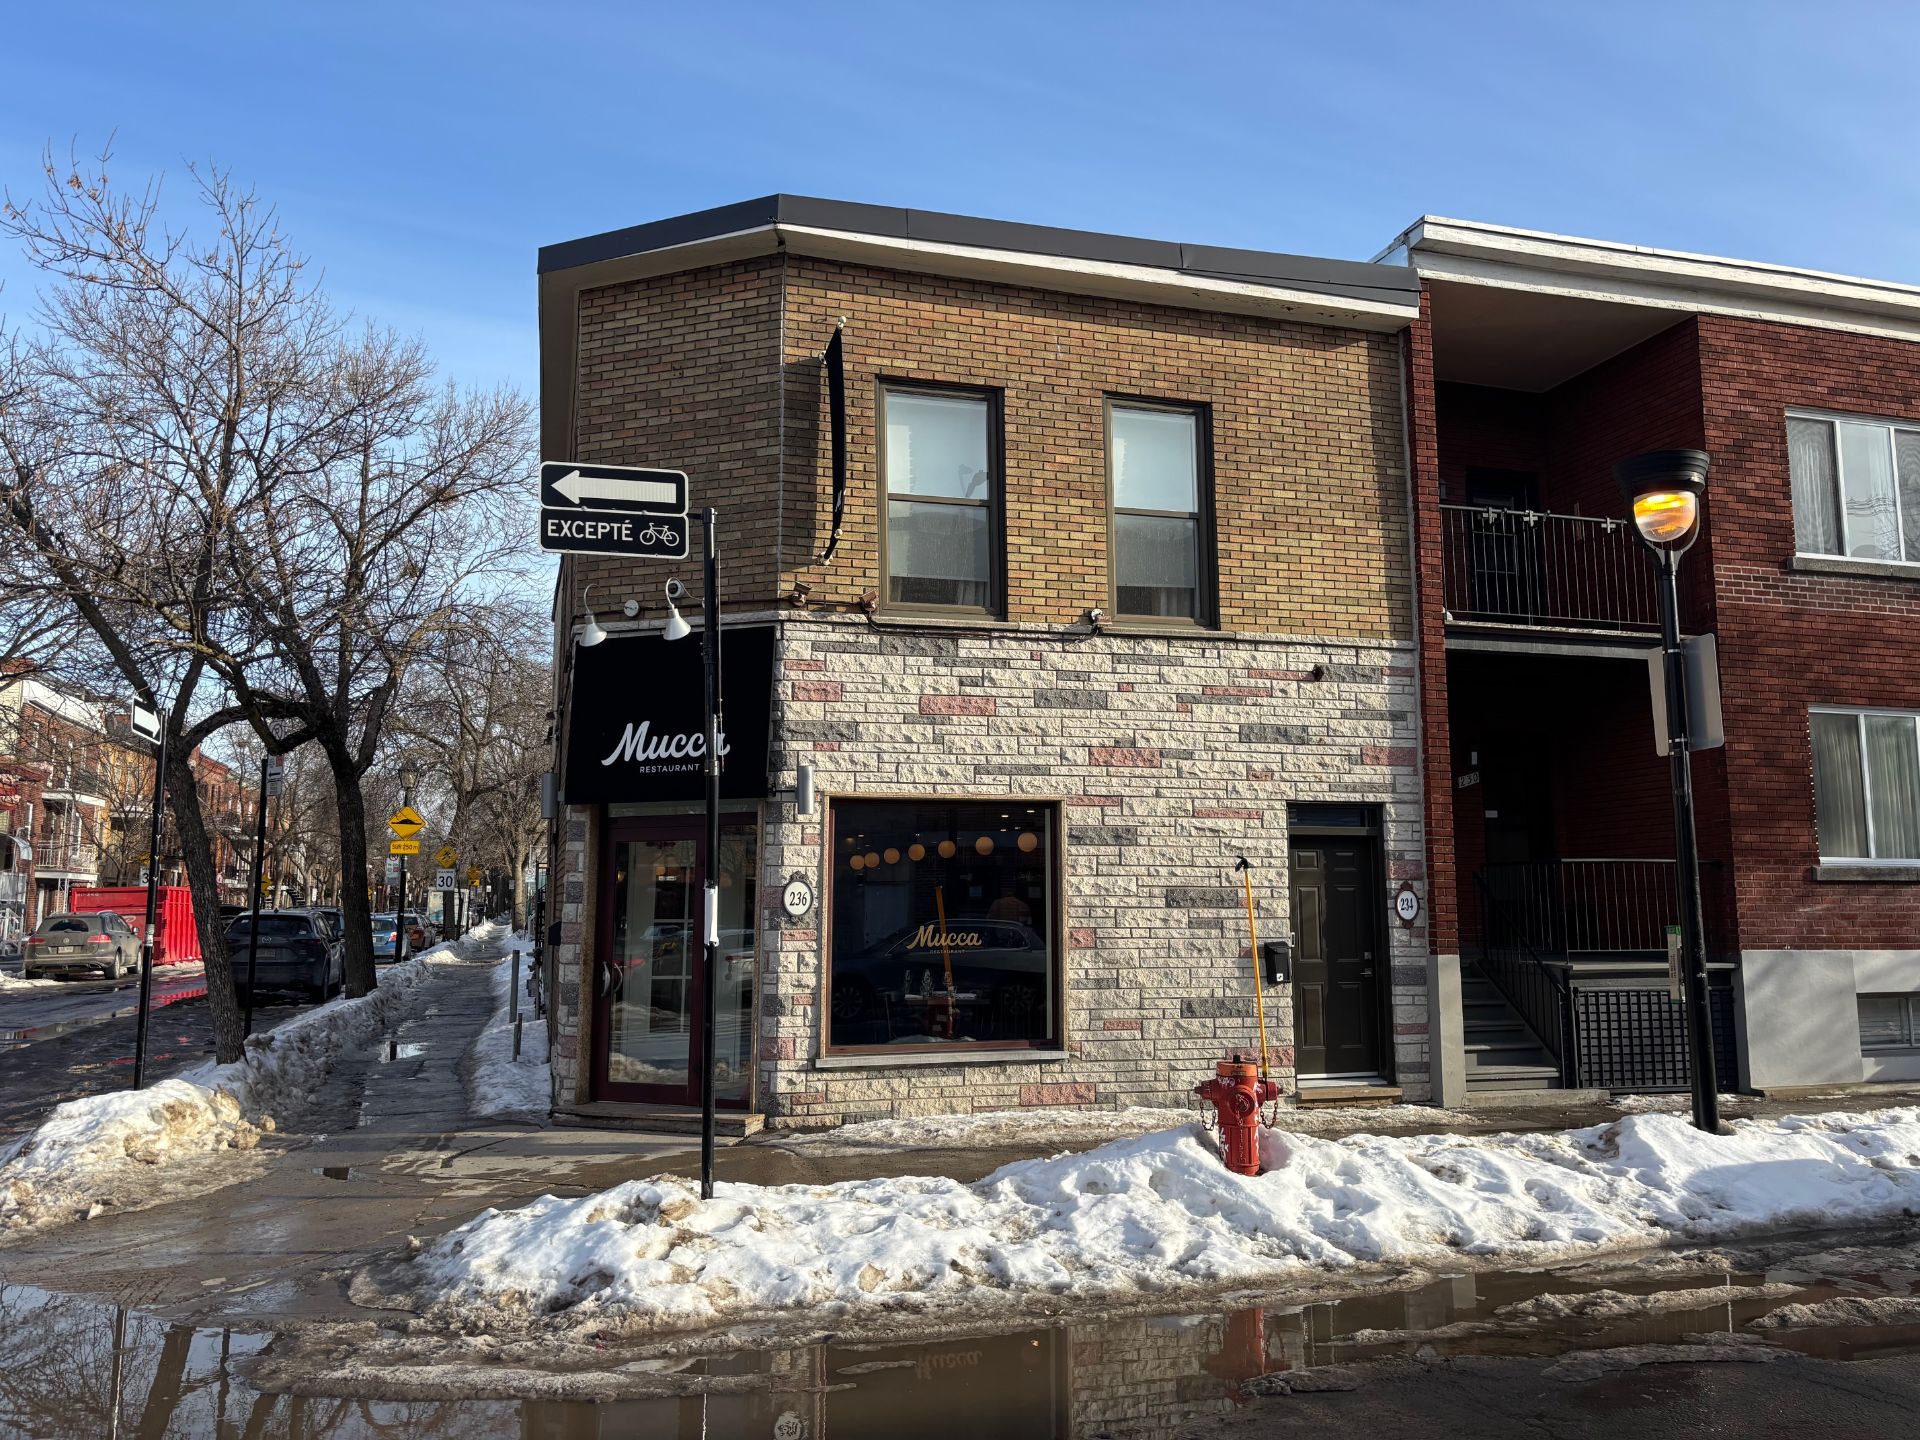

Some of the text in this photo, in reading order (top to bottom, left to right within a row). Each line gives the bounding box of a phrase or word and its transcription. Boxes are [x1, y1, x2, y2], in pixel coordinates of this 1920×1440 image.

[547, 519, 633, 541] EXCEPTÉ
[639, 763, 700, 774] RESTAURANT
[1460, 773, 1478, 786] 230
[438, 875, 453, 888] 30
[789, 891, 808, 906] 236
[1400, 897, 1414, 911] 234
[906, 924, 982, 950] Mucca
